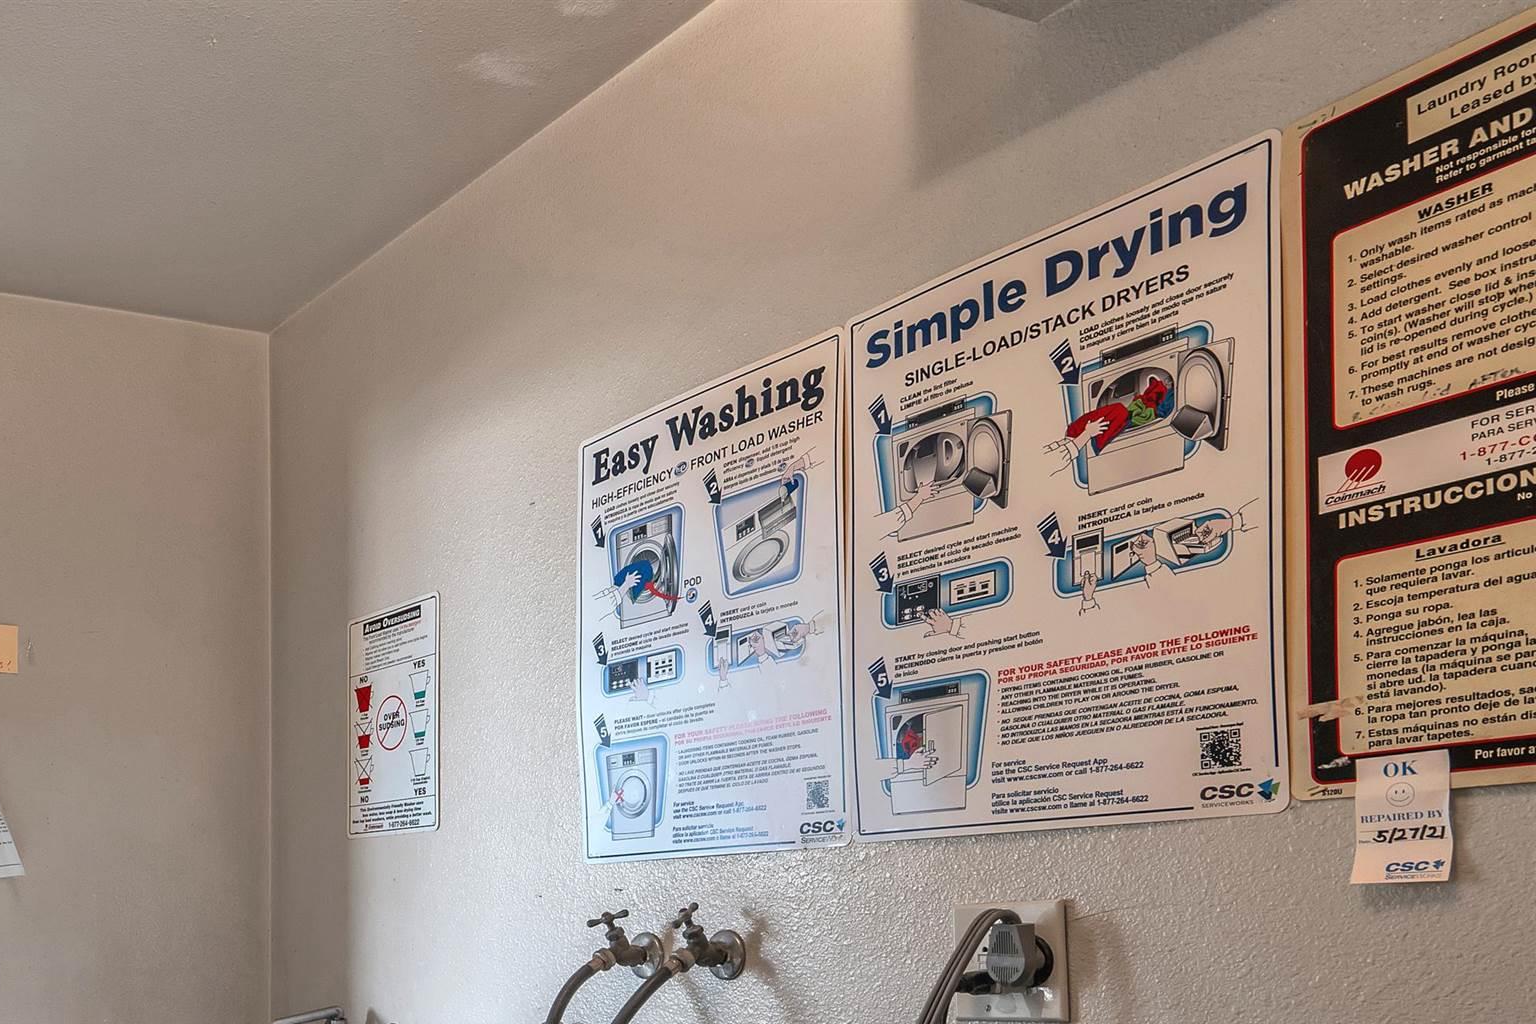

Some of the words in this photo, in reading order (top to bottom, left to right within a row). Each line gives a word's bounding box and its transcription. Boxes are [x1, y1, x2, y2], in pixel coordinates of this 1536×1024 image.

[1417, 76, 1487, 115] Laundry
[1450, 81, 1514, 119] Leased
[1343, 138, 1459, 200] WASHER
[1468, 107, 1533, 148] AND
[1435, 160, 1453, 175] Not
[1456, 135, 1518, 166] responsible
[1435, 167, 1463, 184] Refer
[1466, 160, 1477, 171] to
[1479, 143, 1524, 167] garment
[1417, 182, 1493, 219] WASHER
[1347, 254, 1357, 263] 1.
[1360, 243, 1385, 258] Only
[1388, 232, 1417, 248] wash
[1420, 218, 1452, 236] items
[1455, 203, 1486, 222] rated
[1488, 198, 1503, 209] as
[1347, 279, 1357, 288] 2.
[1360, 264, 1393, 283] Select
[1396, 247, 1439, 269] desired
[1441, 231, 1485, 252] washer
[1487, 212, 1532, 236] control
[1360, 244, 1415, 269] washable.
[864, 274, 1027, 369] Simple
[1044, 181, 1249, 297] Drying
[1347, 302, 1357, 311] 3.
[1360, 290, 1387, 307] Load
[1390, 276, 1431, 297] clothes
[1434, 261, 1473, 281] evenly
[1476, 250, 1499, 266] and
[1360, 272, 1407, 293] settings.
[1347, 316, 1357, 325] 4.
[1360, 307, 1382, 321] Add
[1385, 287, 1442, 312] detergent.
[1448, 277, 1471, 290] See
[1474, 268, 1497, 281] box
[1347, 330, 1357, 339] 5.
[1360, 325, 1374, 335] To
[1377, 314, 1402, 329] start
[1405, 300, 1446, 320] washer
[1449, 288, 1481, 305] close
[1484, 280, 1500, 293] lid
[1503, 276, 1513, 286] &
[904, 301, 1095, 387] SINGLE-LOAD/STACK
[1101, 264, 1190, 312] DRYERS
[1360, 326, 1401, 346] coin(s).
[1403, 309, 1451, 332] (Washer
[1454, 300, 1474, 314] will
[1478, 291, 1505, 306] stop
[1360, 345, 1374, 356] lid
[1377, 342, 1386, 350] is
[1389, 321, 1447, 347] re-opened
[1449, 308, 1489, 326] during
[1492, 292, 1533, 313] cycle.)
[1348, 366, 1358, 375] 6.
[1361, 359, 1380, 370] For
[1382, 350, 1406, 364] best
[1408, 337, 1448, 355] results
[1451, 321, 1497, 341] remove
[1361, 360, 1410, 383] promptly
[1412, 355, 1424, 365] at
[1426, 346, 1448, 361] end
[1451, 341, 1464, 352] of
[1467, 328, 1511, 347] washer
[1348, 390, 1359, 400] 7.
[1361, 380, 1394, 395] These
[1397, 362, 1452, 385] machines
[1455, 356, 1474, 367] are
[1477, 347, 1498, 360] not
[1361, 397, 1372, 406] to
[1375, 388, 1404, 402] wash
[1407, 379, 1436, 393] rugs.
[1495, 383, 1535, 401] Please
[591, 434, 659, 485] Easy
[664, 365, 826, 452] Washing
[1471, 414, 1500, 429] FOR
[1471, 426, 1505, 441] PARA
[591, 468, 673, 510] HIGH-EFFICIENCY
[690, 447, 728, 471] FRONT
[731, 433, 765, 456] LOAD
[767, 410, 824, 440] WASHER
[1078, 508, 1108, 522] INSERT
[1109, 503, 1126, 513] card
[1136, 497, 1153, 506] coin
[1324, 483, 1386, 506] Coinmach
[1078, 511, 1132, 530] INTRODUZCA
[1141, 503, 1165, 514] tarjeta
[1173, 492, 1205, 505] moneda
[1415, 534, 1502, 559] Lavadora
[683, 575, 702, 589] POD
[1353, 616, 1363, 625] 3.
[1366, 610, 1402, 623] Ponga
[1405, 607, 1419, 616] su
[1423, 602, 1453, 613] ropa.
[413, 659, 426, 669] YES
[997, 668, 1016, 678] FOR
[1018, 663, 1044, 674] YOUR
[1046, 656, 1083, 669] SAFETY
[1085, 648, 1123, 662] PLEASE
[1125, 642, 1157, 655] AVOID
[1159, 637, 1181, 648] THE
[1183, 625, 1251, 643] FOLLOWING
[997, 676, 1014, 684] POR
[1015, 673, 1026, 681] SU
[1027, 669, 1058, 680] PROPIA
[1059, 660, 1109, 674] SEGURIDAD,
[1111, 656, 1128, 665] POR
[1130, 650, 1159, 661] FAVOR
[1161, 645, 1188, 656] EVITE
[1190, 642, 1202, 651] LO
[1205, 633, 1258, 648] SIGUIENTE
[383, 711, 400, 722] OVER
[1355, 730, 1365, 739] 7.
[1368, 727, 1399, 738] Estas
[1402, 720, 1459, 733] máquinas
[1463, 717, 1478, 727] no
[1482, 713, 1517, 725] están
[1368, 738, 1393, 749] para
[1396, 734, 1424, 745] lavar
[1427, 729, 1474, 742] tapetes.
[1475, 748, 1495, 760] Por
[1496, 746, 1526, 758] favor
[1383, 760, 1418, 778] OK
[413, 787, 426, 796] YES
[1200, 783, 1254, 800] CSC
[799, 820, 834, 835] CSC
[1360, 811, 1424, 824] REPAIRED
[1427, 809, 1444, 819] BY
[1372, 824, 1446, 844] 5/27/21
[1385, 860, 1431, 873] CSC
